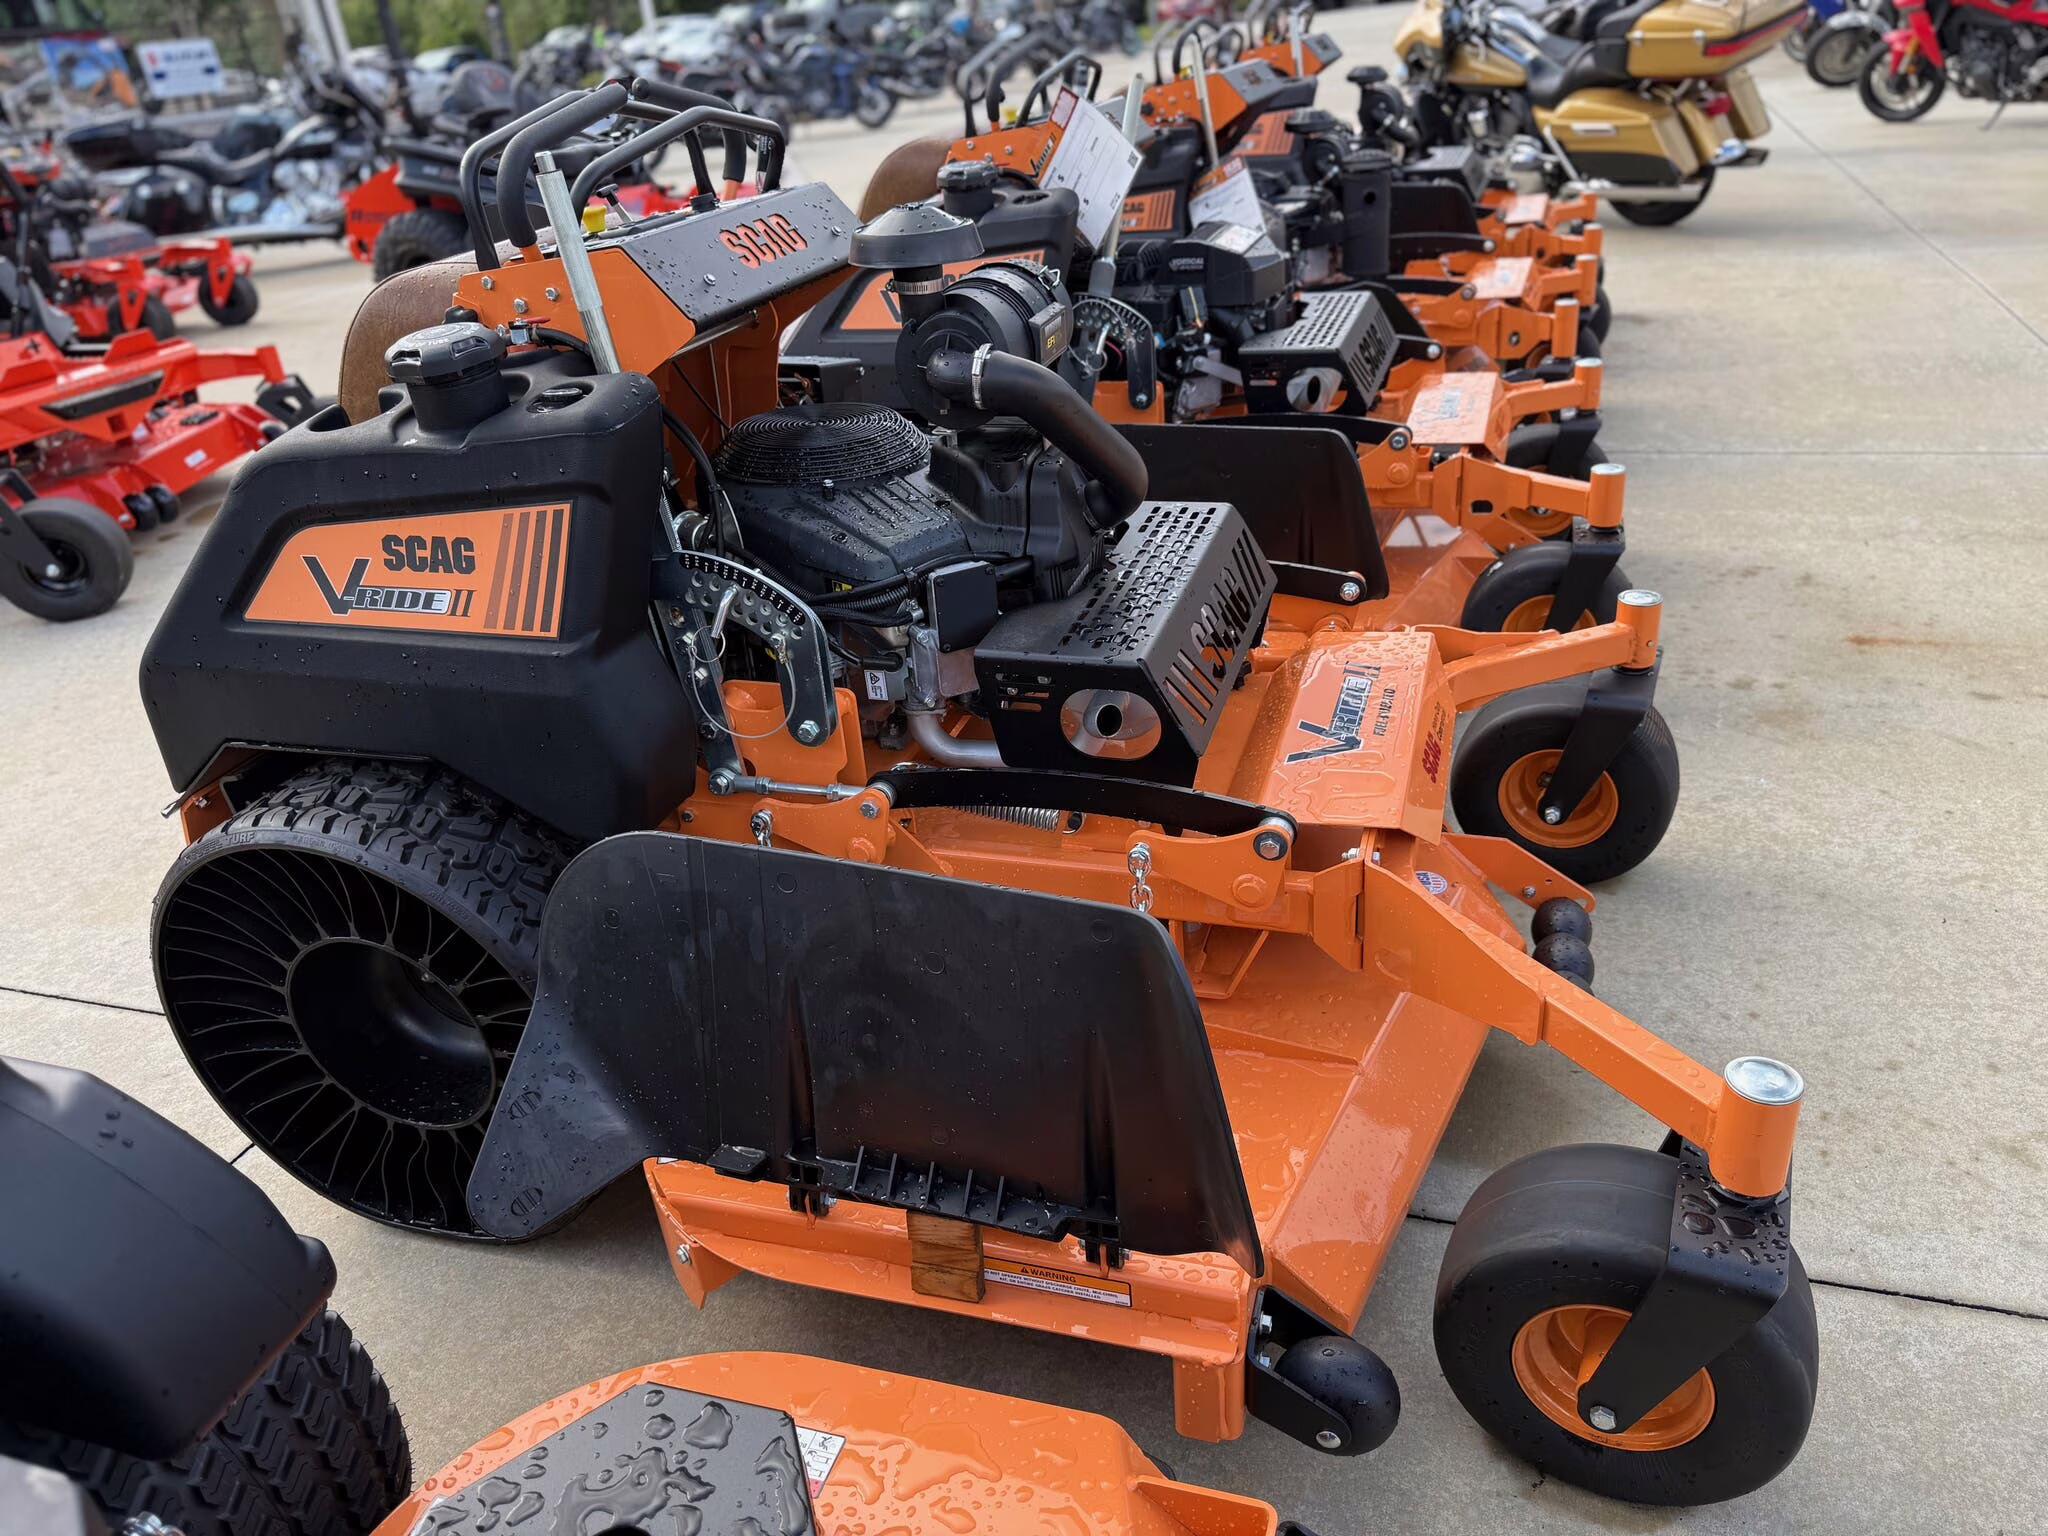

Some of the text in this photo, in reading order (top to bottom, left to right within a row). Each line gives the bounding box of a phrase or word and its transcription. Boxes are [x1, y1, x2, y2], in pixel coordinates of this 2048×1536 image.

[719, 212, 808, 269] SCAG
[381, 534, 476, 575] SCAG
[446, 588, 478, 617] II
[1190, 566, 1251, 684] SCAG
[1421, 731, 1442, 784] SCAG
[1029, 1268, 1077, 1284] WARNING
